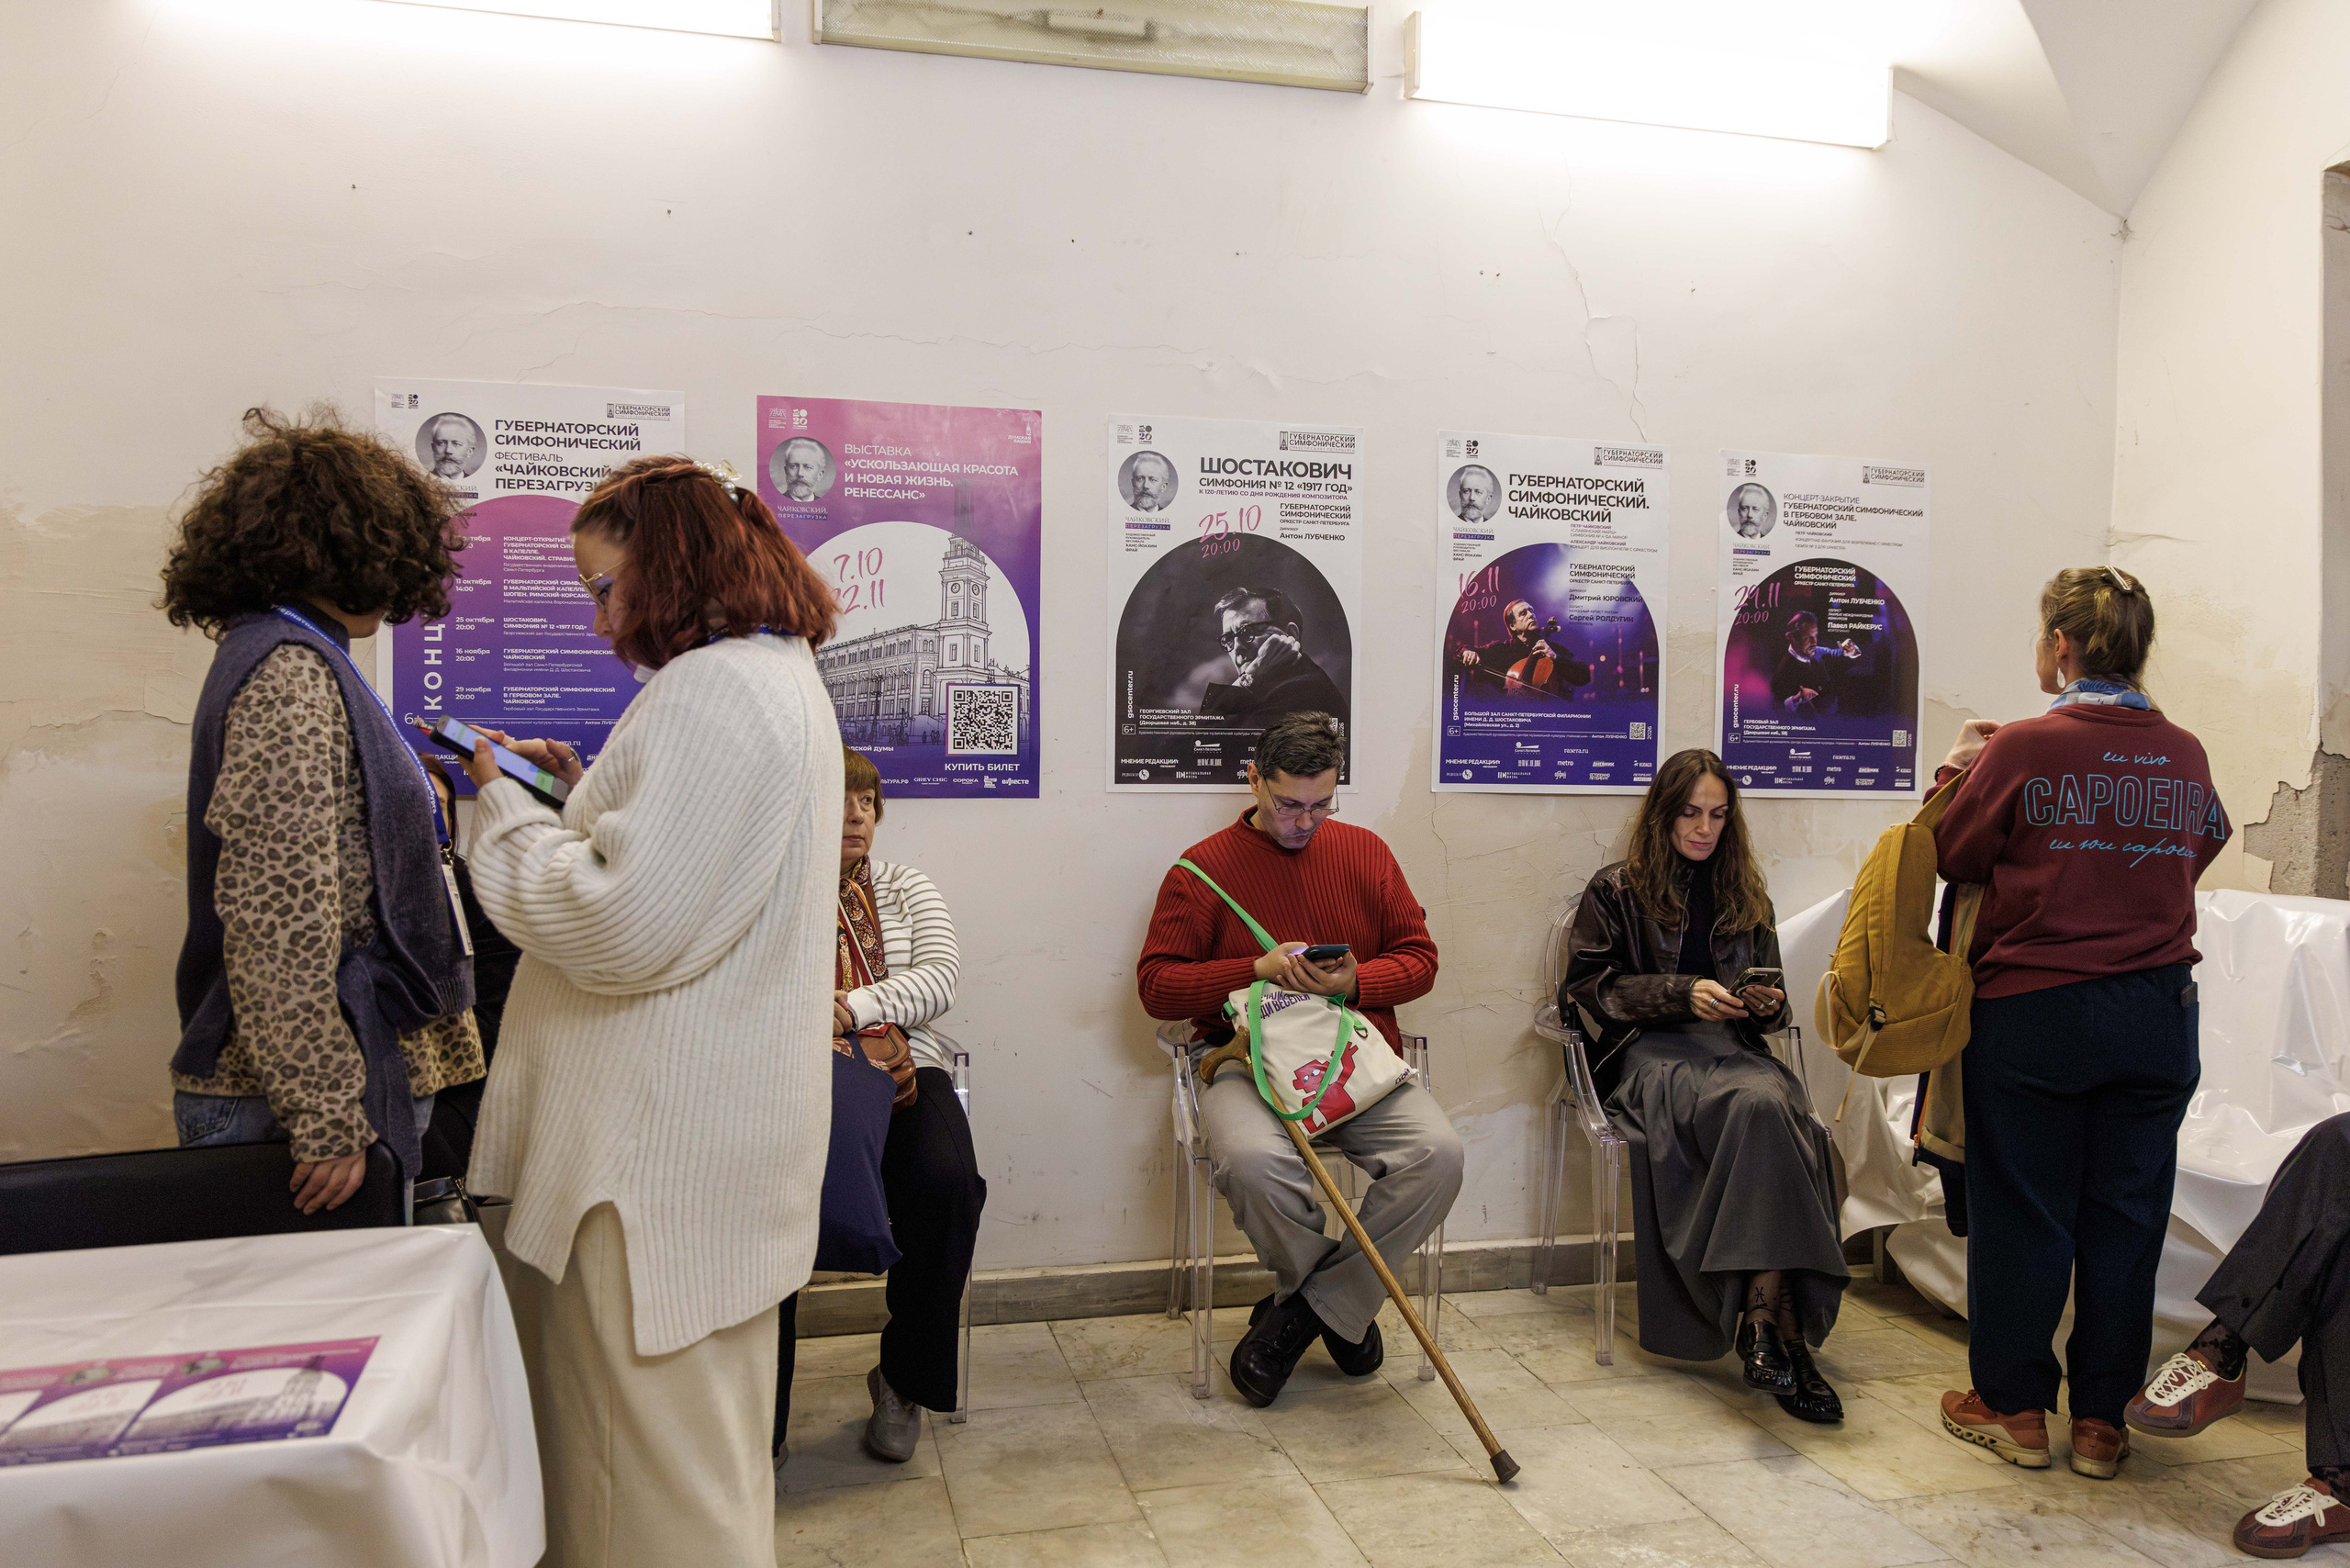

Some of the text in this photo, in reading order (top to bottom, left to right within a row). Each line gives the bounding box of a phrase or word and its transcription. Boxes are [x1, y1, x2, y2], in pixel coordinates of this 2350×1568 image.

[496, 420, 639, 437] ГУБЕРНАТОРСКИЙ
[496, 434, 641, 451] СИМФОНИЧЕСКИЙ
[1289, 439, 1355, 448] СИМФОНИЧЕСКИЙ
[1290, 433, 1355, 442] ГУБЕРНАТОРСКИЙ
[495, 452, 564, 462] ФЕСТИВАЛЬ
[845, 443, 912, 457] ВЫСТАВКА
[1603, 449, 1663, 459] ГУБЕРНАТОРСКИЙ
[1603, 455, 1663, 464] СИМФОНИЧЕСКИЙ
[496, 463, 612, 478] «ЧАЙКОВСКИЙ
[845, 459, 1019, 476] «УСКОЛЬЗАЮЩАЯ КРАСОТА
[1200, 456, 1352, 480] ШОСТАКОВИЧ
[496, 478, 597, 492] ПЕРЕЗАГРУЗ
[845, 473, 954, 487] И НОВАЯ ЖИЗНЬ.
[1199, 477, 1353, 494] СИМФОНИЯ № 12 «1917 ГОД»
[1509, 474, 1644, 493] ГУБЕРНАТОРСКИЙ
[845, 487, 925, 500] РЕНЕССАНС»
[1508, 489, 1650, 510] СИМФОНИЧЕСКИЙ.
[1784, 493, 1860, 504] КОНЦЕРТ-ЗАКРЫТИЕ
[777, 505, 828, 514] ЧАЙКОВСКИЙ.
[1280, 503, 1351, 512] ГУБЕРНАТОРСКИЙ
[1508, 504, 1612, 523] ЧАЙКОВСКИЙ
[1784, 503, 1923, 517] ГУБЕРНАТОРСКИЙ СИМФОНИЧЕСКИЙ
[1280, 511, 1351, 519] СИМФОНИЧЕСКИЙ
[1199, 504, 1261, 543] 25.10
[1784, 520, 1836, 529] ЧАЙКОВСКИЙ
[1202, 538, 1240, 559] 20:00
[1569, 571, 1635, 579] СИМФОНИЧЕСКИЙ
[1795, 566, 1856, 574] ГУБЕРНАТОРСКИЙ
[463, 579, 492, 588] октября
[1459, 566, 1500, 599] 16.11
[1795, 573, 1856, 582] СИМФОНИЧЕСКИЙ
[1734, 582, 1781, 611] 29.11
[1460, 594, 1497, 614] 20:00
[1734, 610, 1769, 625] 20:00
[2103, 751, 2171, 765] eu vivo
[2024, 774, 2225, 840] CAPOEIRA
[2049, 839, 2075, 849] eu
[2079, 840, 2117, 850] sou
